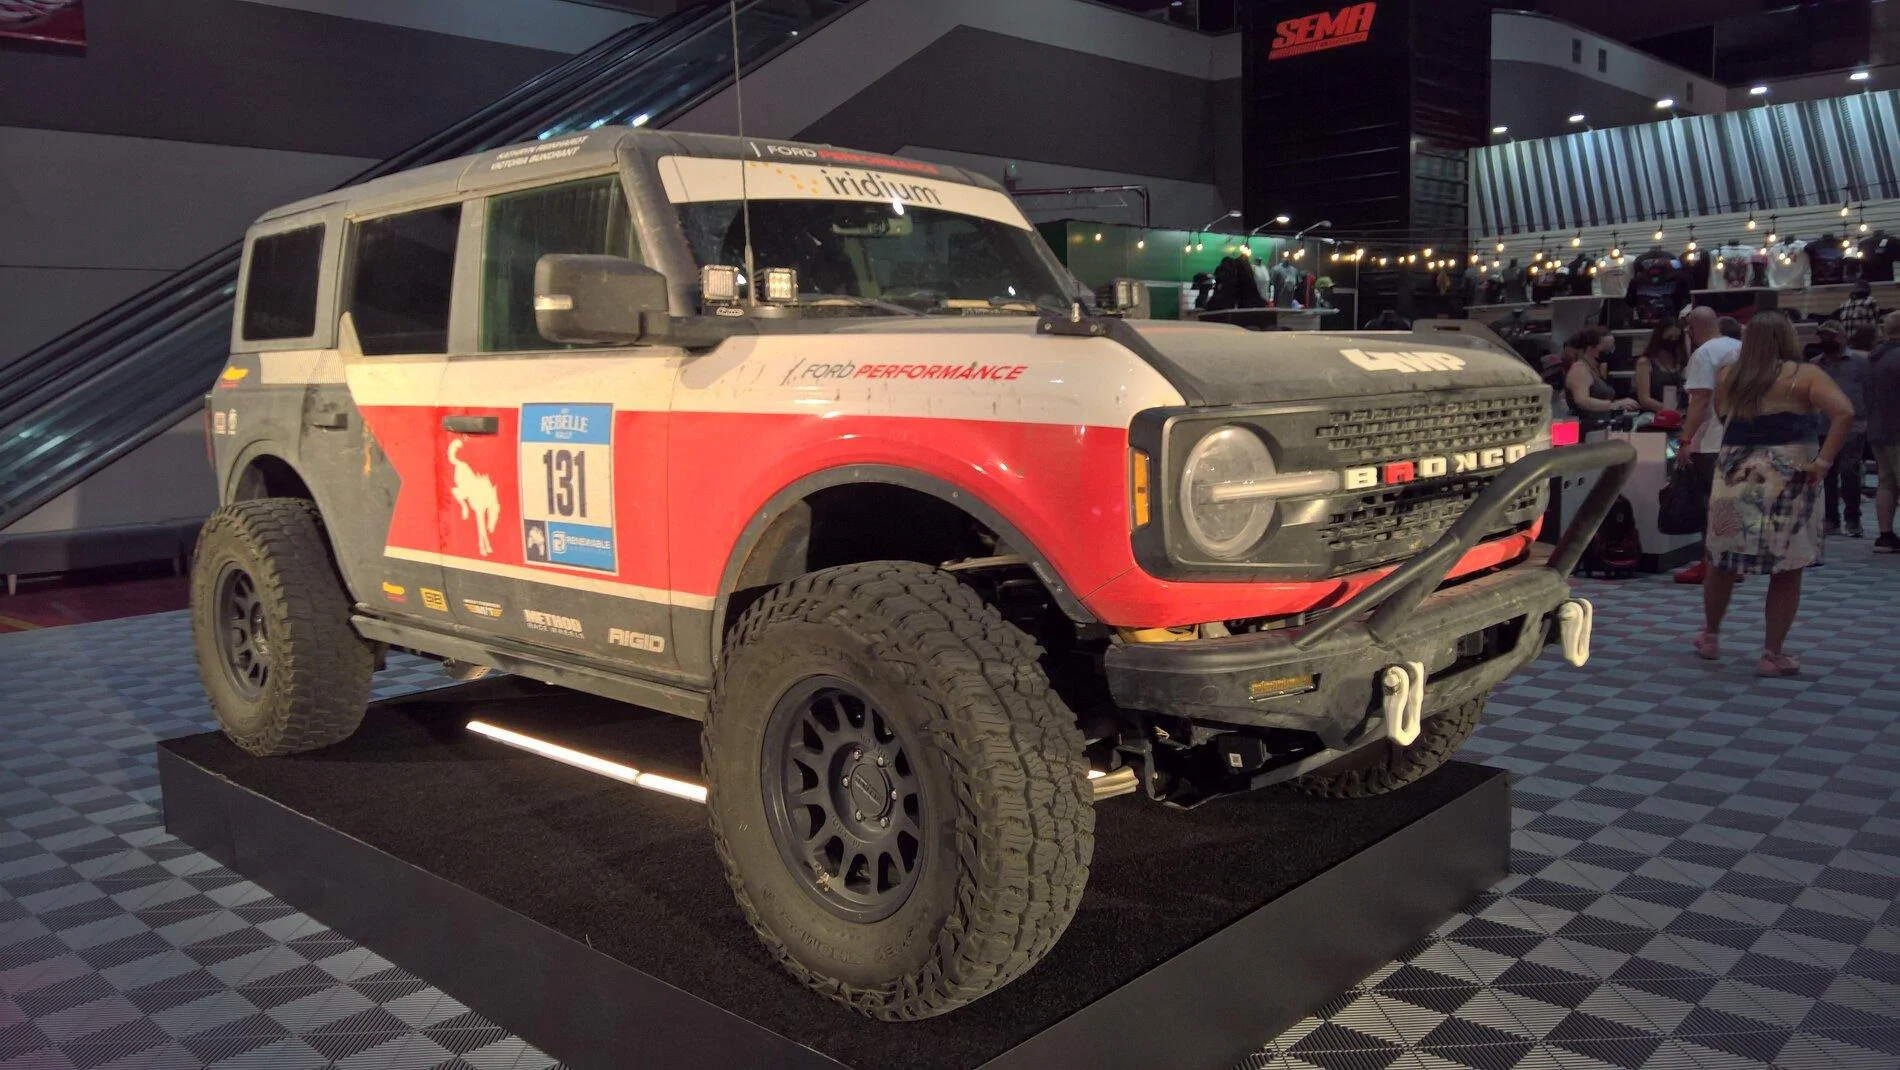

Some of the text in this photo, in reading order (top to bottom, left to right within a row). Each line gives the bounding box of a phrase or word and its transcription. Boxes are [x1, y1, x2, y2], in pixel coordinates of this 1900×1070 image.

[1272, 2, 1376, 48] SEMA
[767, 144, 817, 158] FORD
[821, 168, 942, 206] iridium
[801, 361, 1028, 381] FORD PERFORMANCE
[540, 414, 588, 435] REBELLE
[1344, 444, 1526, 490] BRONCO
[543, 449, 587, 518] 131
[522, 609, 583, 632] METHOD
[608, 627, 666, 653] RIGID
